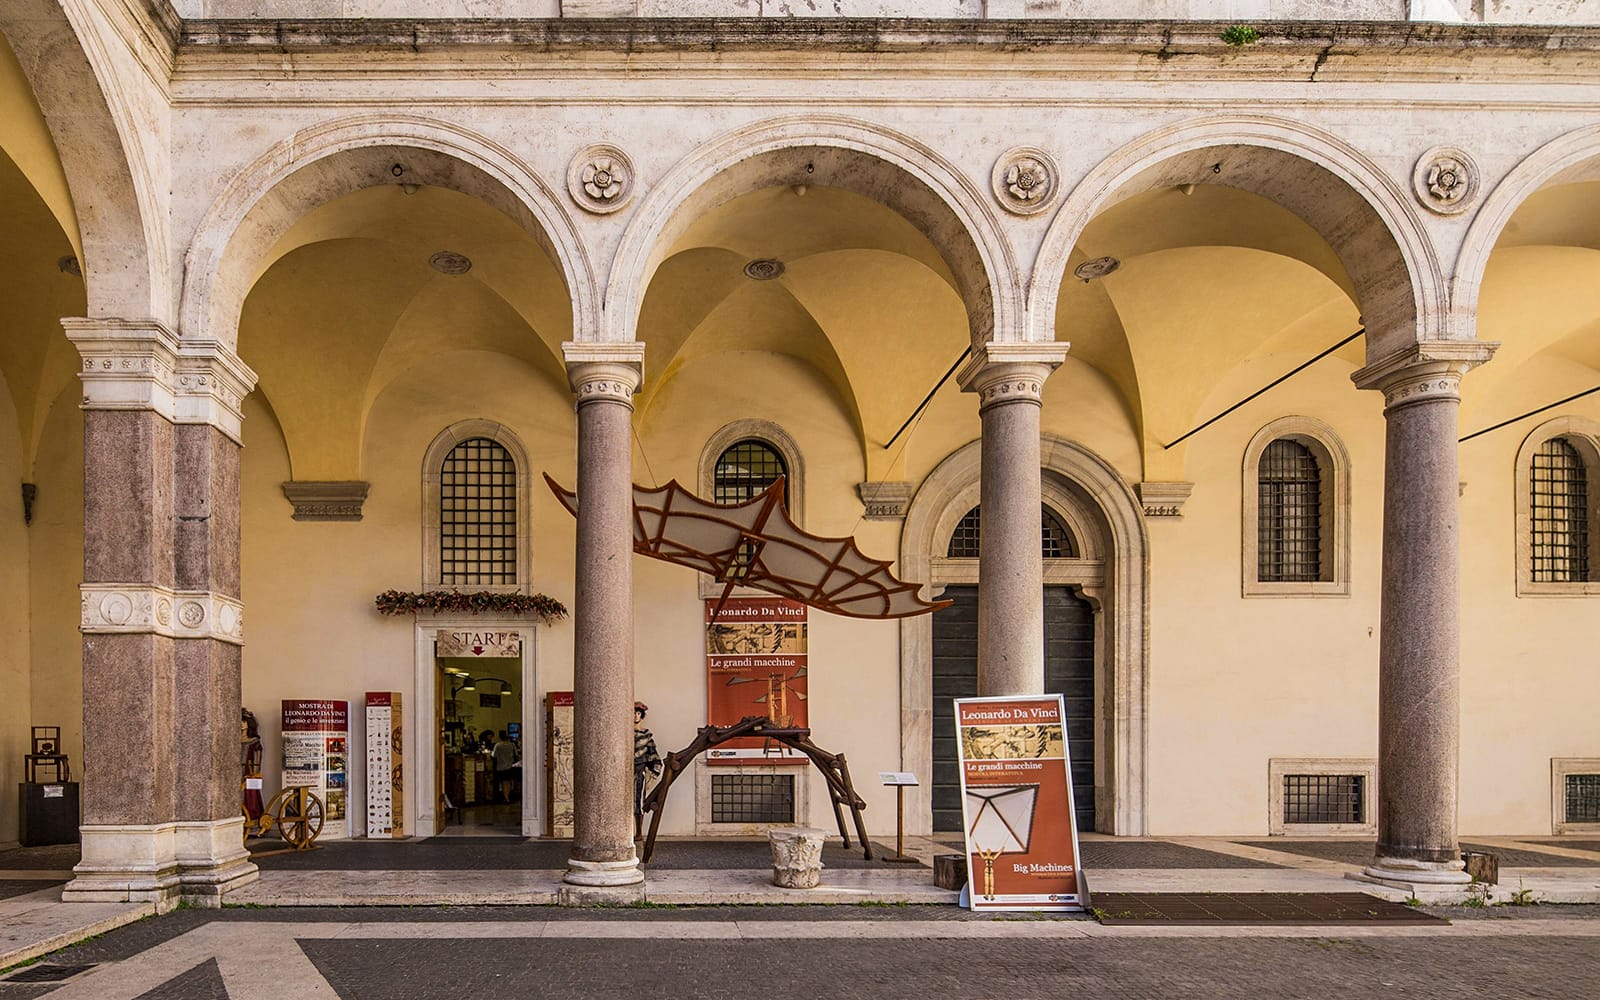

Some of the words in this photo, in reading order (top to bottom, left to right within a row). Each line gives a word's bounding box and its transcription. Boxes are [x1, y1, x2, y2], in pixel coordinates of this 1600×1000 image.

[761, 607, 775, 616] Da
[778, 607, 804, 616] Vinci
[452, 632, 505, 646] START
[711, 658, 721, 667] Le
[723, 657, 752, 669] grandi
[754, 657, 796, 667] macchine
[962, 708, 1011, 720] Leonardo
[1014, 709, 1028, 719] Da
[1030, 707, 1058, 718] Vinci
[967, 763, 977, 771] Le
[978, 762, 1004, 772] grandi
[1005, 761, 1043, 770] macchine
[1013, 863, 1028, 874] Big
[1030, 862, 1073, 872] Machines
